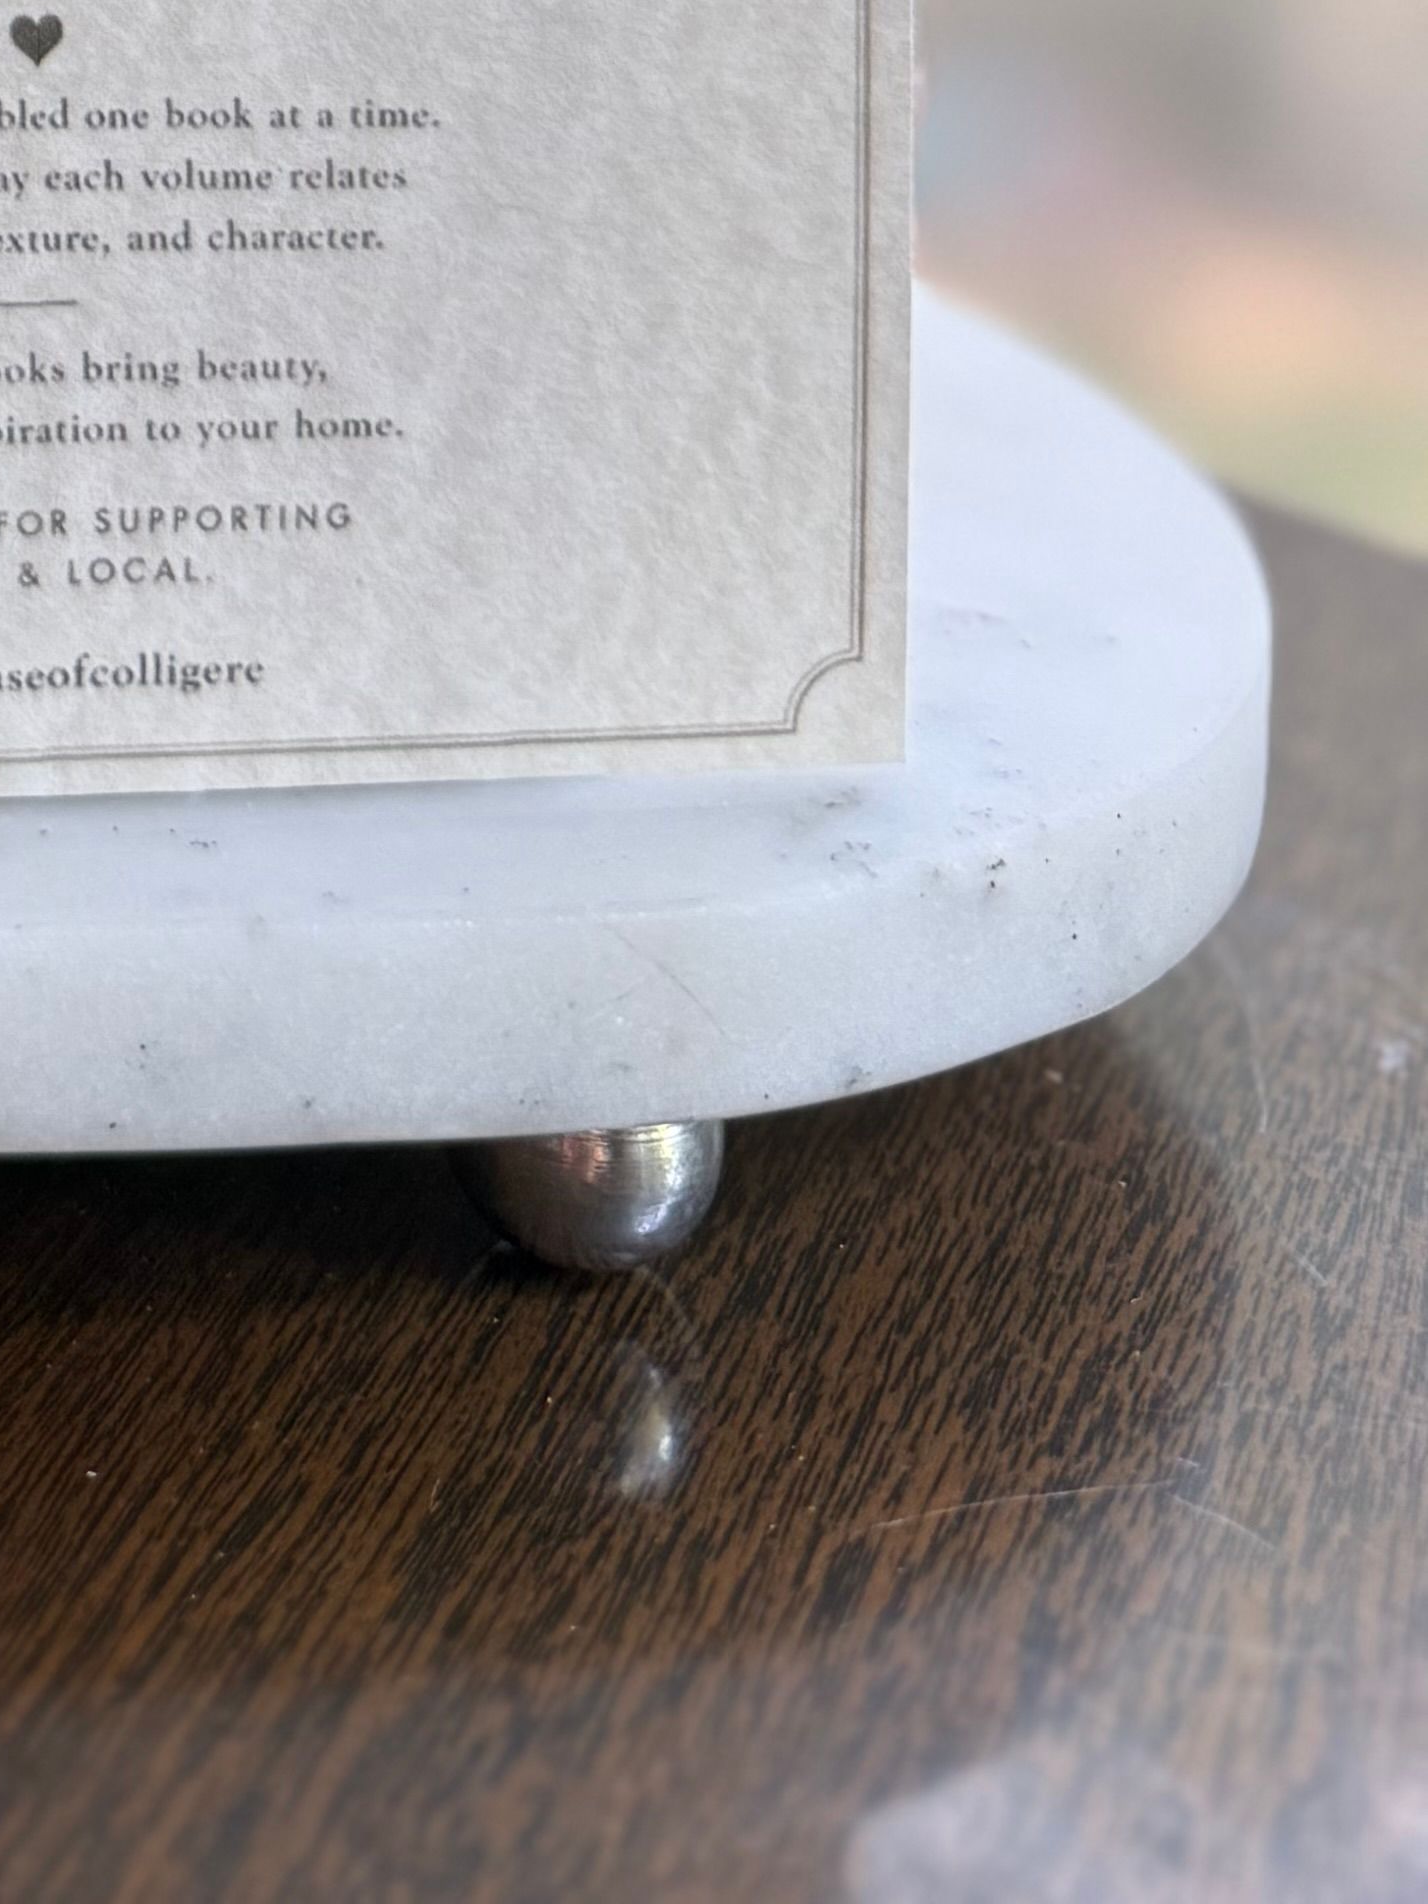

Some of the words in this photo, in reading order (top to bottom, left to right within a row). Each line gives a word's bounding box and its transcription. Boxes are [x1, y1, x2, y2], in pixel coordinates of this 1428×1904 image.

[83, 108, 150, 131] one
[164, 96, 254, 131] book
[268, 105, 302, 131] at
[315, 108, 335, 130] a
[349, 98, 441, 130] time.
[43, 158, 126, 193] each
[140, 157, 274, 193] volume
[289, 157, 408, 192] relates
[127, 218, 194, 254] and
[206, 217, 385, 254] character.
[81, 349, 181, 391] bring
[196, 348, 328, 388] beauty,
[145, 418, 182, 444] to
[196, 419, 279, 450] your
[295, 407, 405, 440] home.
[94, 502, 353, 539] SUPPORTING
[17, 561, 42, 590] &
[67, 556, 213, 589] LOCAL.
